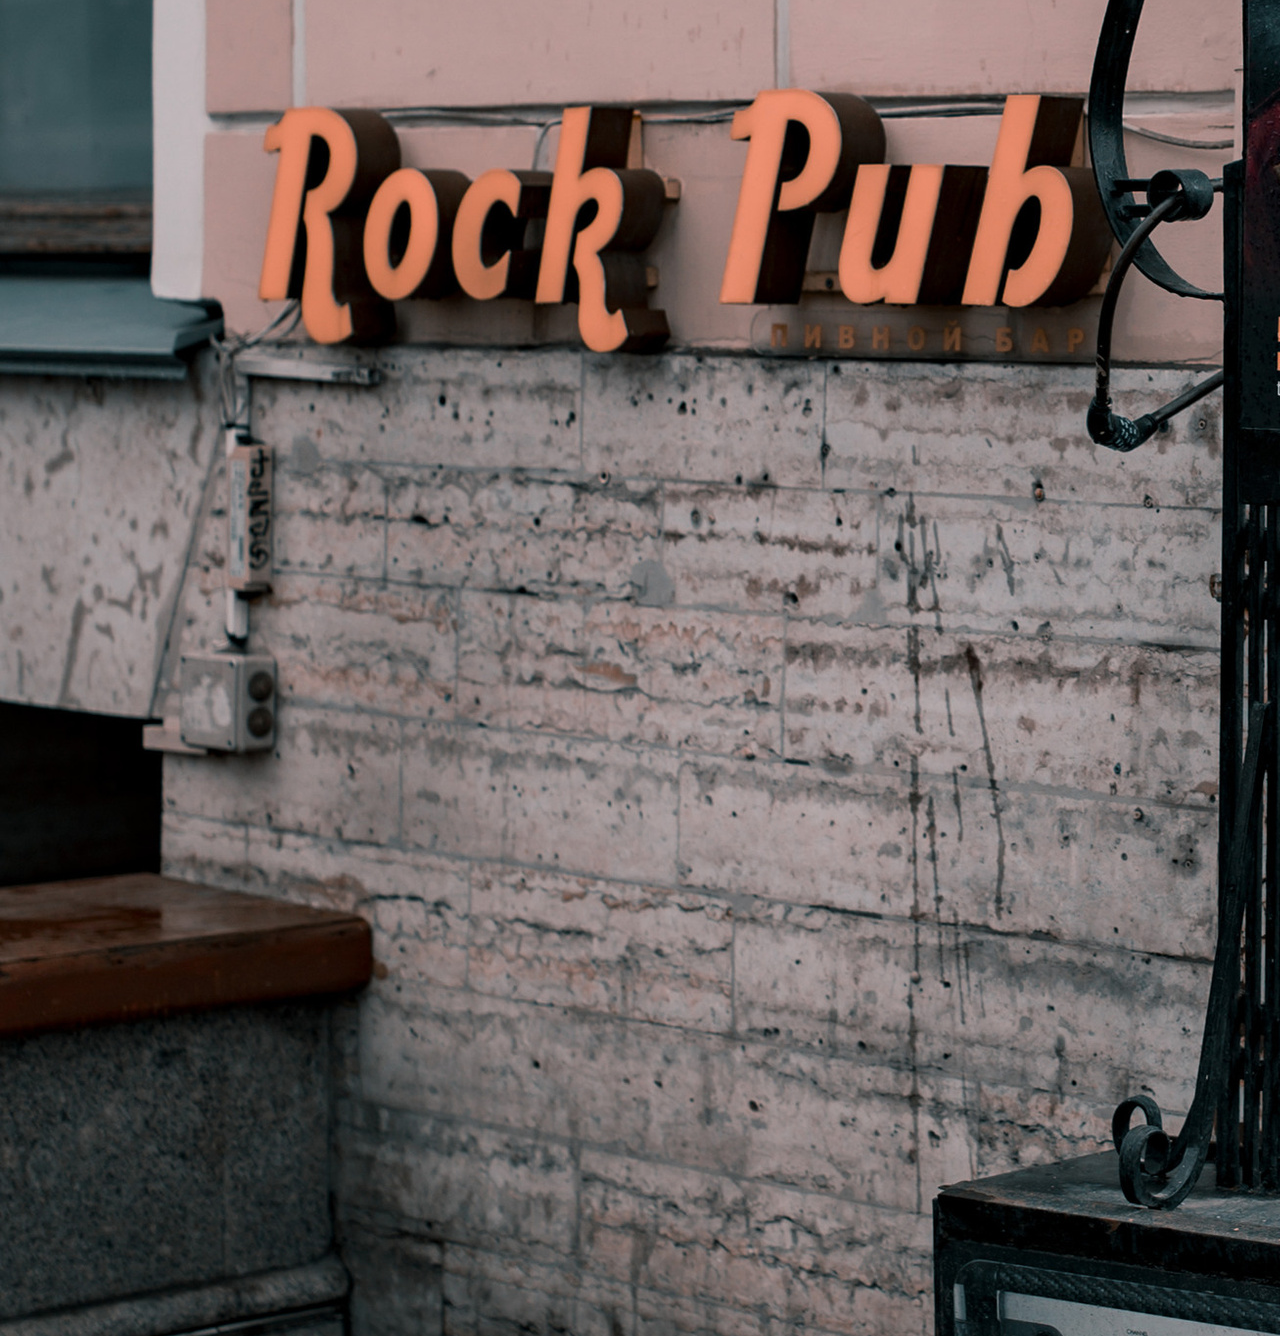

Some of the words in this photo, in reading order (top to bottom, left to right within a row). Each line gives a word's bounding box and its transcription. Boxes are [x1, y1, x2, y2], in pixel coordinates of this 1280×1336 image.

[259, 105, 630, 354] Rock
[720, 88, 1075, 308] Pub
[770, 321, 963, 352] ПИВНОЙ
[995, 327, 1086, 353] БАР
